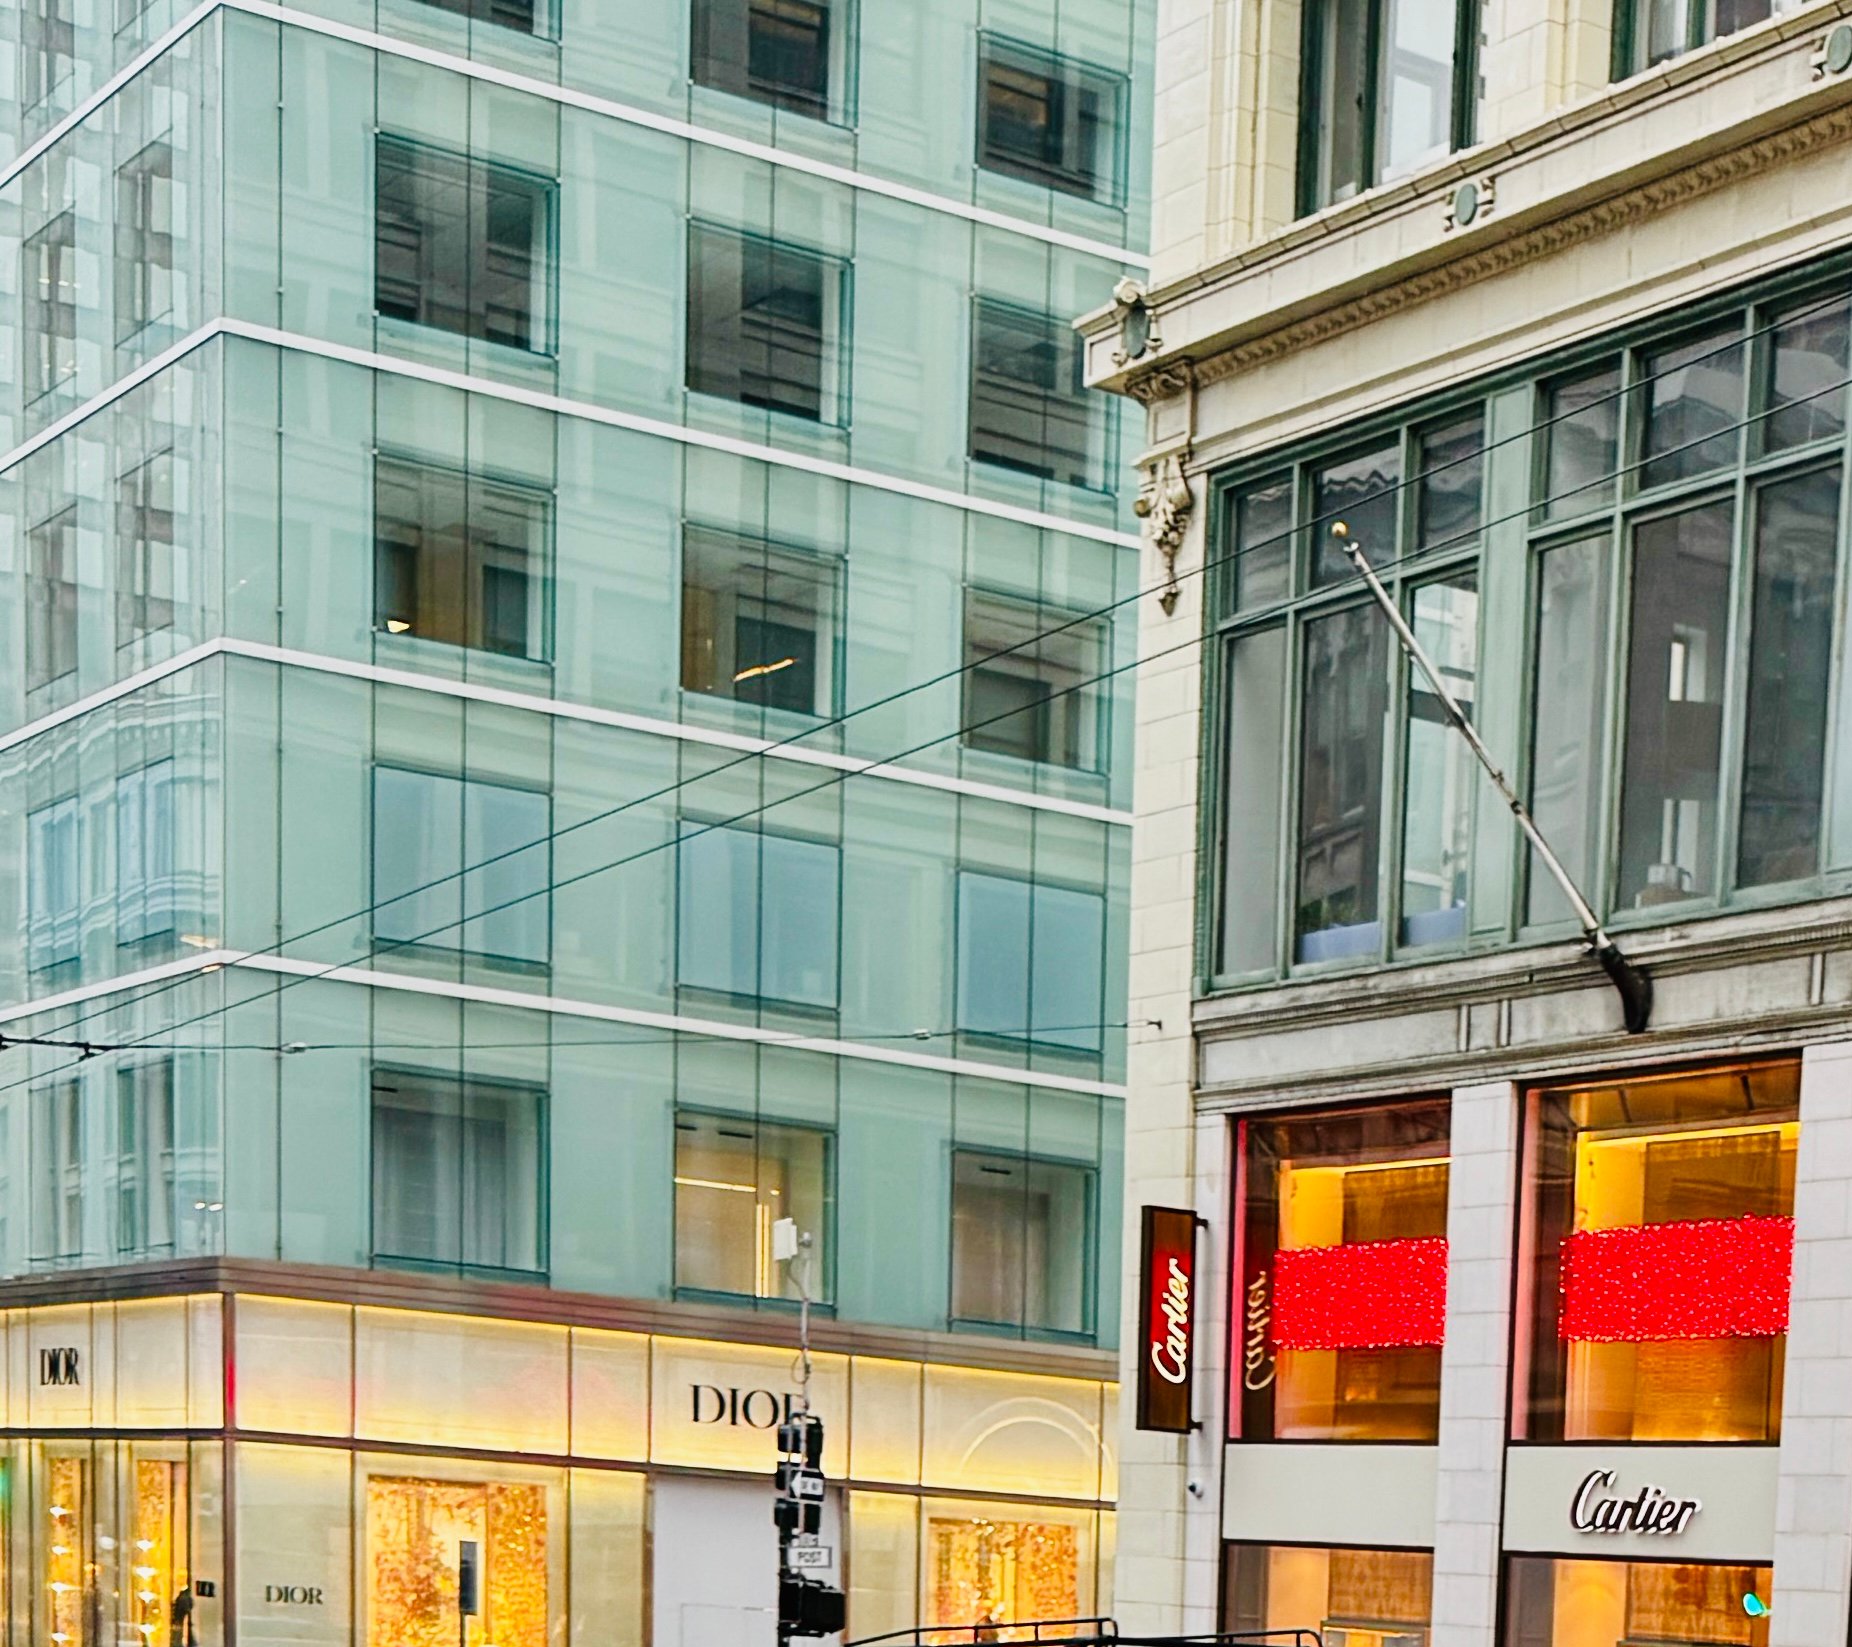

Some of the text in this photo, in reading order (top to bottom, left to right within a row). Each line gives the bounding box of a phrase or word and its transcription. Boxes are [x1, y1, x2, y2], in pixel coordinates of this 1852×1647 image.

[1151, 1257, 1189, 1384] Cartier
[40, 1348, 80, 1386] DIOR
[1570, 1467, 1703, 1535] Cartier
[266, 1585, 323, 1605] DIOR
